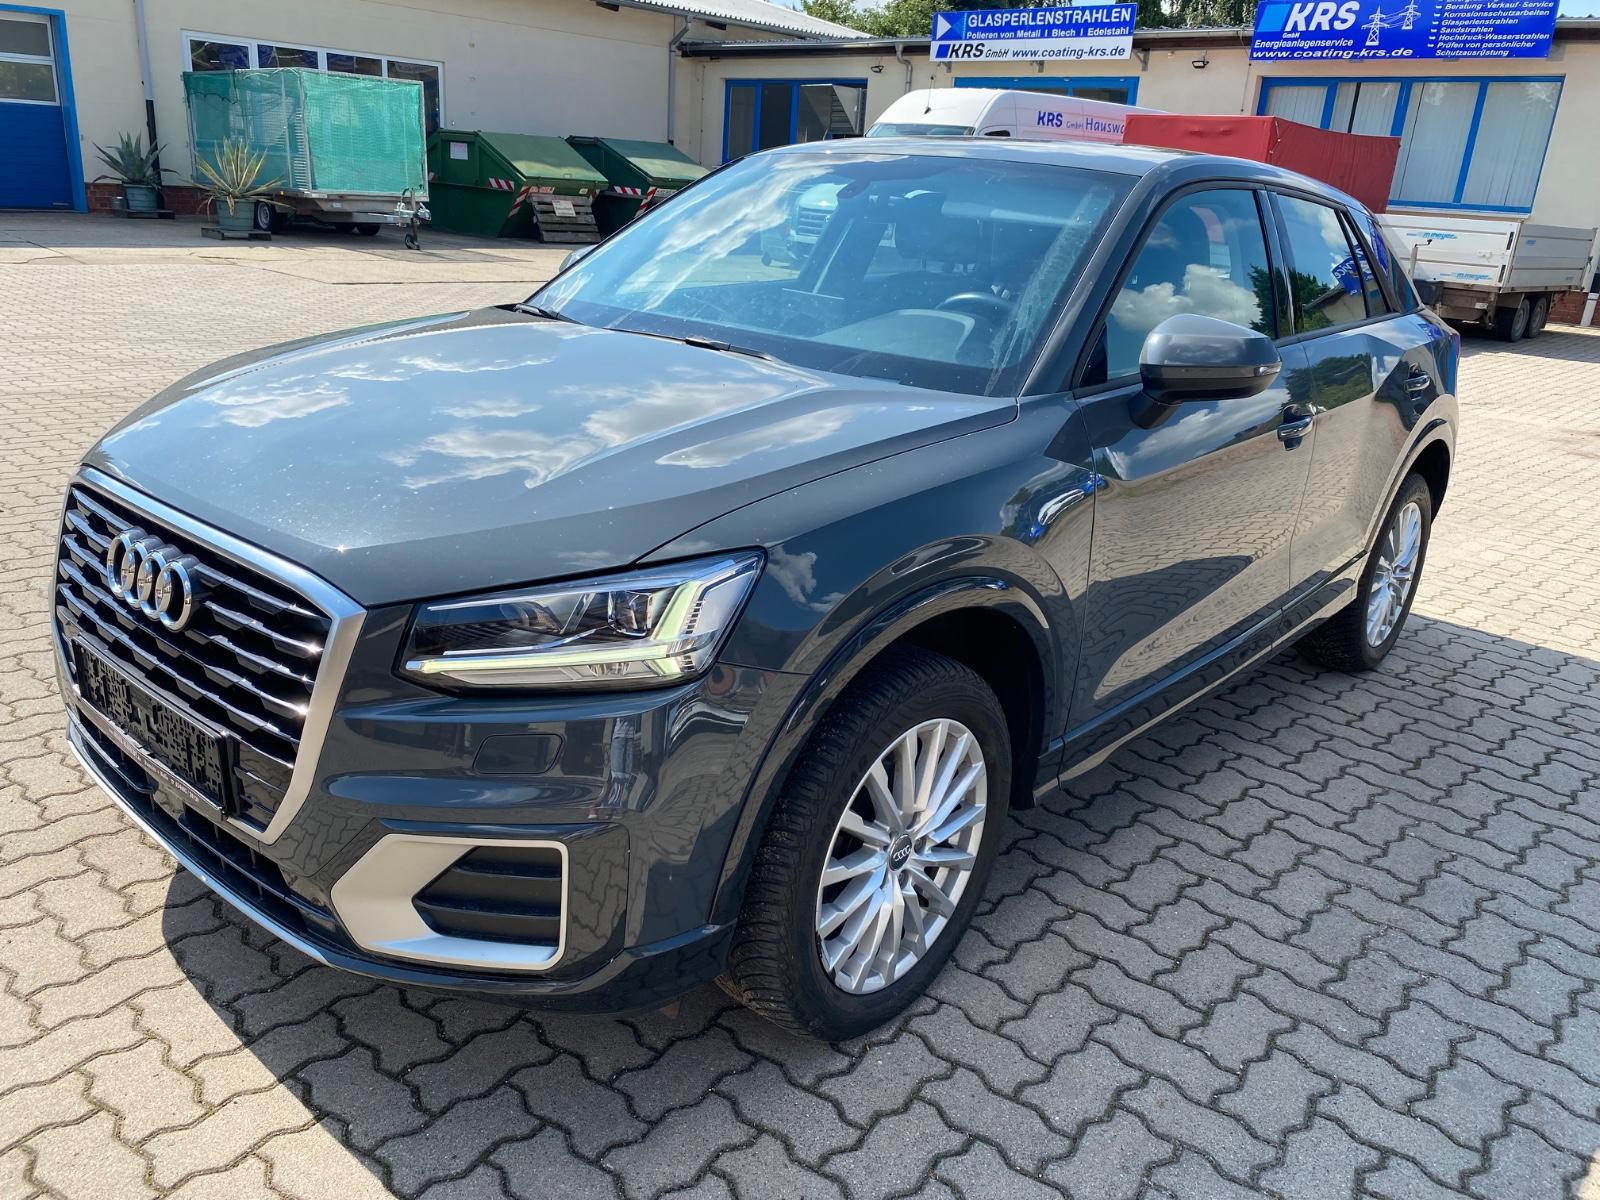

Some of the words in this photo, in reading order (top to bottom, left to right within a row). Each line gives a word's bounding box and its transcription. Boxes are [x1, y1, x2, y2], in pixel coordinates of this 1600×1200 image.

[968, 8, 1131, 27] GLASPERLENSTRAHLEN
[1284, 2, 1360, 31] KRS
[1443, 10, 1550, 18] Korrosionsschutzarbeiten
[1441, 18, 1518, 26] Glasperlenstrahlen
[966, 31, 998, 39] Polieren
[1000, 30, 1015, 38] von
[1016, 29, 1041, 38] Metall
[1052, 28, 1076, 37] Blech
[1087, 26, 1129, 36] Edelstahl
[1440, 26, 1493, 34] Sandstrahlen
[1439, 33, 1550, 41] Hochdruck-Wasserstrahlen
[1254, 38, 1354, 50] Energieanlagenservice
[1437, 41, 1463, 49] Prüfen
[949, 42, 985, 59] KRS
[985, 48, 1009, 58] GmbH
[1012, 45, 1126, 60] www.coating-krs.de
[1252, 48, 1414, 58] www.coating-krs.de
[1435, 49, 1509, 57] Schutzausrüstung
[1037, 111, 1063, 128] KRS
